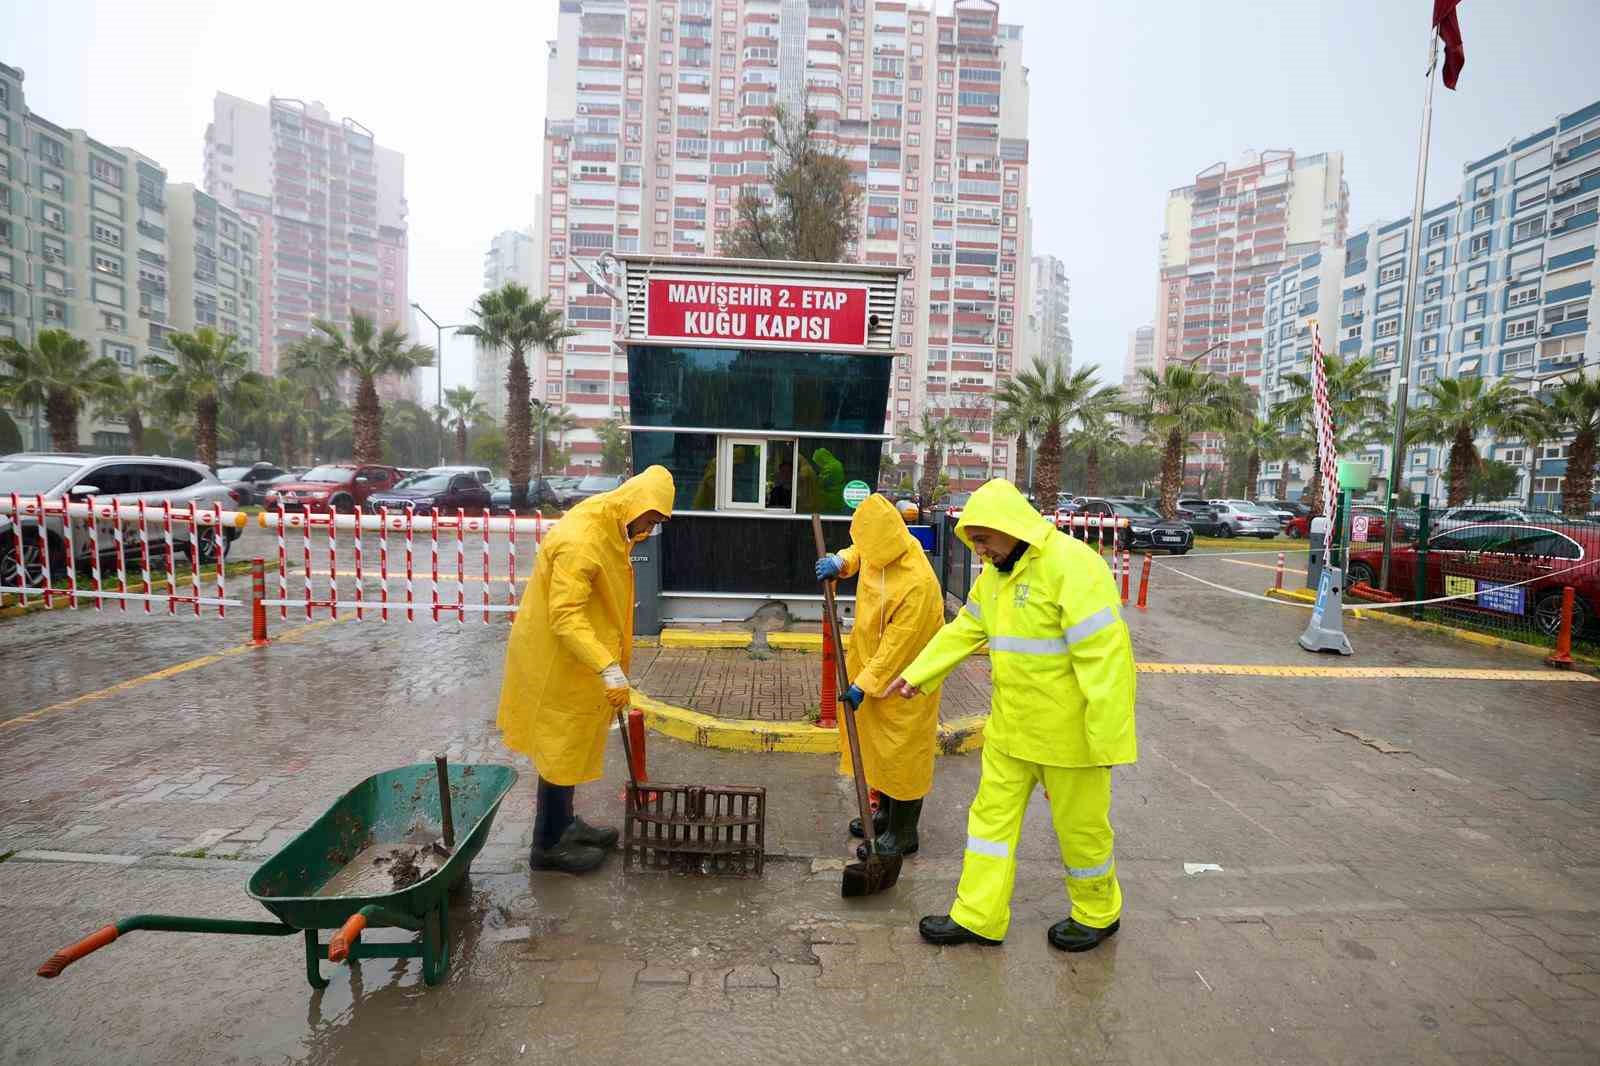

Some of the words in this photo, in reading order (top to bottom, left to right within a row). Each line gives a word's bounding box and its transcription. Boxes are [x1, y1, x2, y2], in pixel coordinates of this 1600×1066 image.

[668, 282, 773, 308] MAVİŞEHİR
[777, 289, 796, 308] 2.
[801, 290, 848, 311] ETAP
[684, 303, 747, 337] KUĞU
[755, 314, 831, 340] KAPISI
